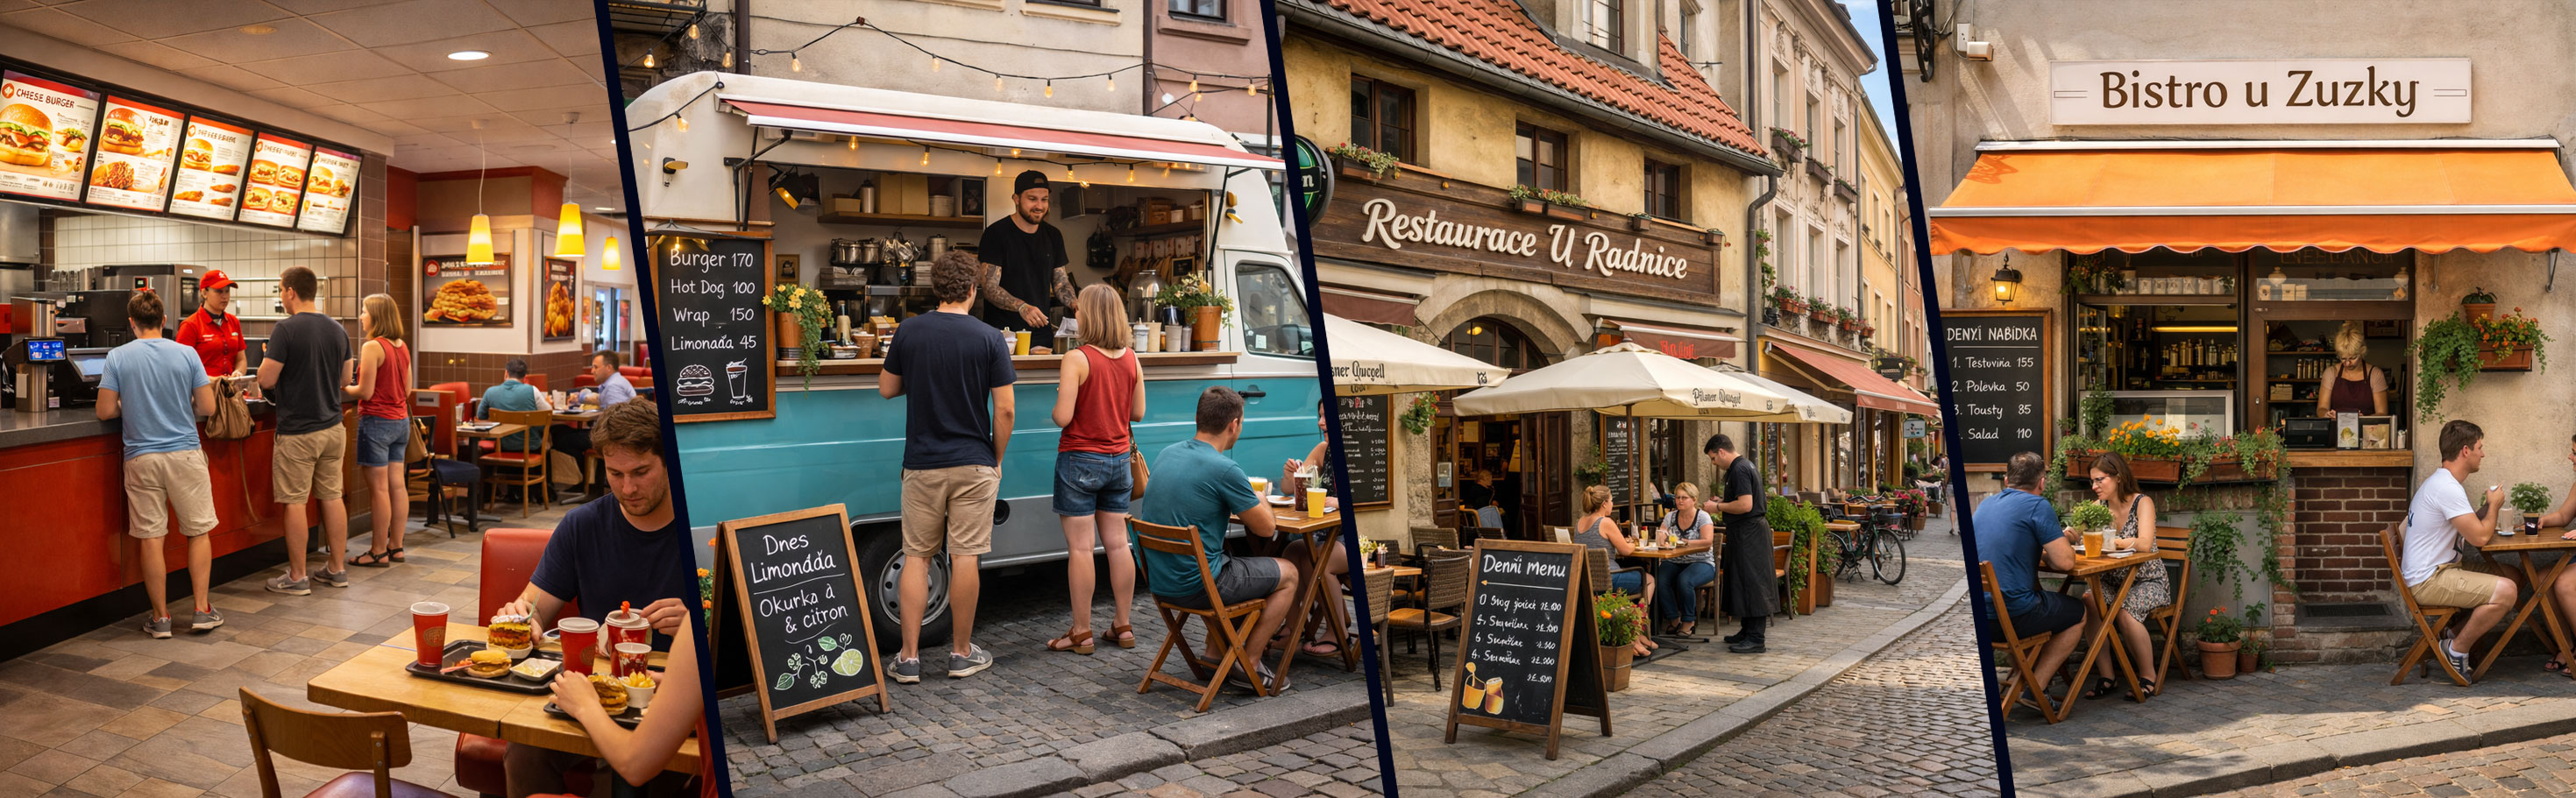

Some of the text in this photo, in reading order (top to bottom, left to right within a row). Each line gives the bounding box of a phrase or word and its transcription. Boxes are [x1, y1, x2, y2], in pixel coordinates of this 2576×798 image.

[2099, 66, 2420, 118] Bistro u Zuzky
[1361, 198, 1688, 280] Restaurace U Radnice
[671, 249, 754, 273] Burger 170
[671, 279, 756, 300] Hot Dog 100
[673, 307, 755, 328] Wrap 150
[740, 335, 757, 350] 45
[1952, 357, 1962, 369] 1.
[2016, 357, 2034, 368] 155
[1951, 380, 1962, 392] 2.
[2015, 381, 2030, 392] 50
[1968, 404, 2004, 420] Tousty
[2018, 404, 2032, 415] 85
[1968, 427, 1999, 440] Salad
[2016, 427, 2033, 439] 110
[763, 534, 810, 556] Dnes
[1526, 561, 1566, 578] menu
[760, 590, 819, 618] Okurka
[785, 616, 798, 633] &
